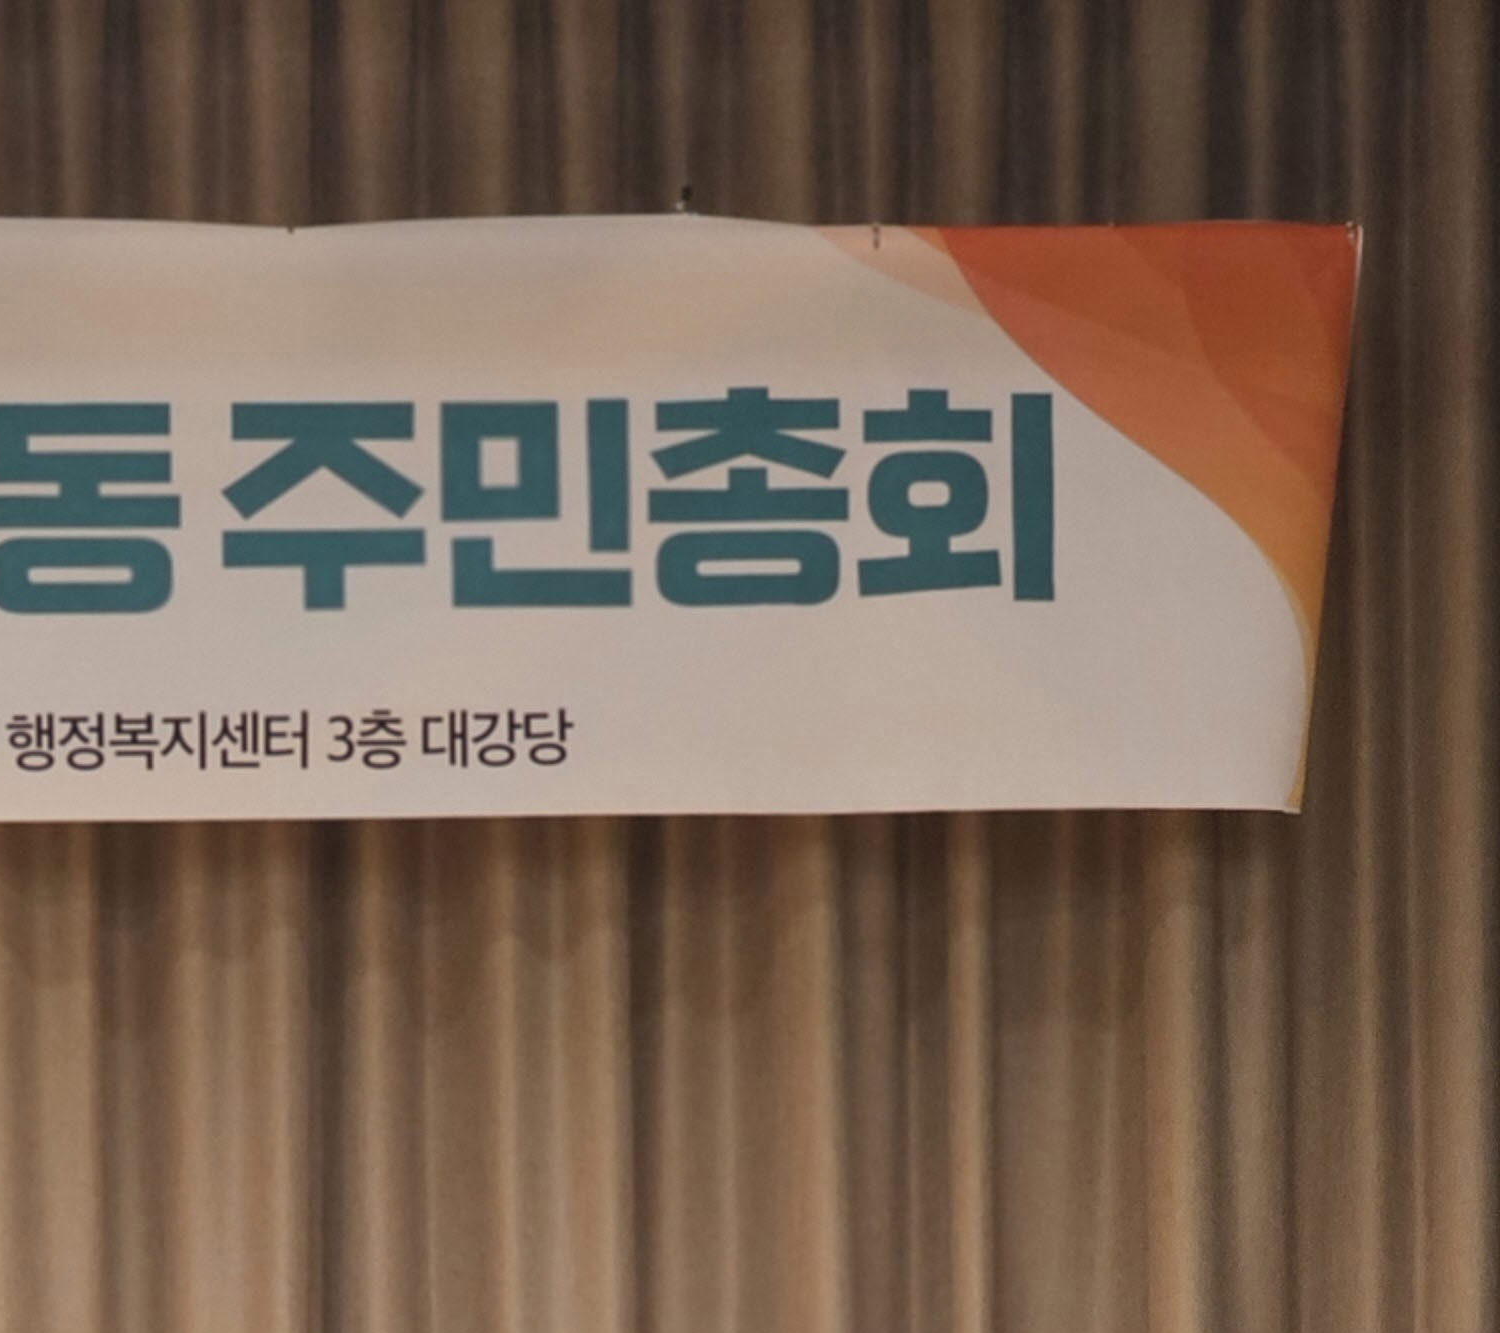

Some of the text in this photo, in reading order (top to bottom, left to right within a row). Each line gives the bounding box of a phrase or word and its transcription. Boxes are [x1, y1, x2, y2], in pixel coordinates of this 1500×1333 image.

[221, 386, 1055, 611] 주민총회
[6, 709, 310, 772] 행정복지센터
[326, 709, 408, 770] 3층
[420, 707, 575, 768] 대강당
